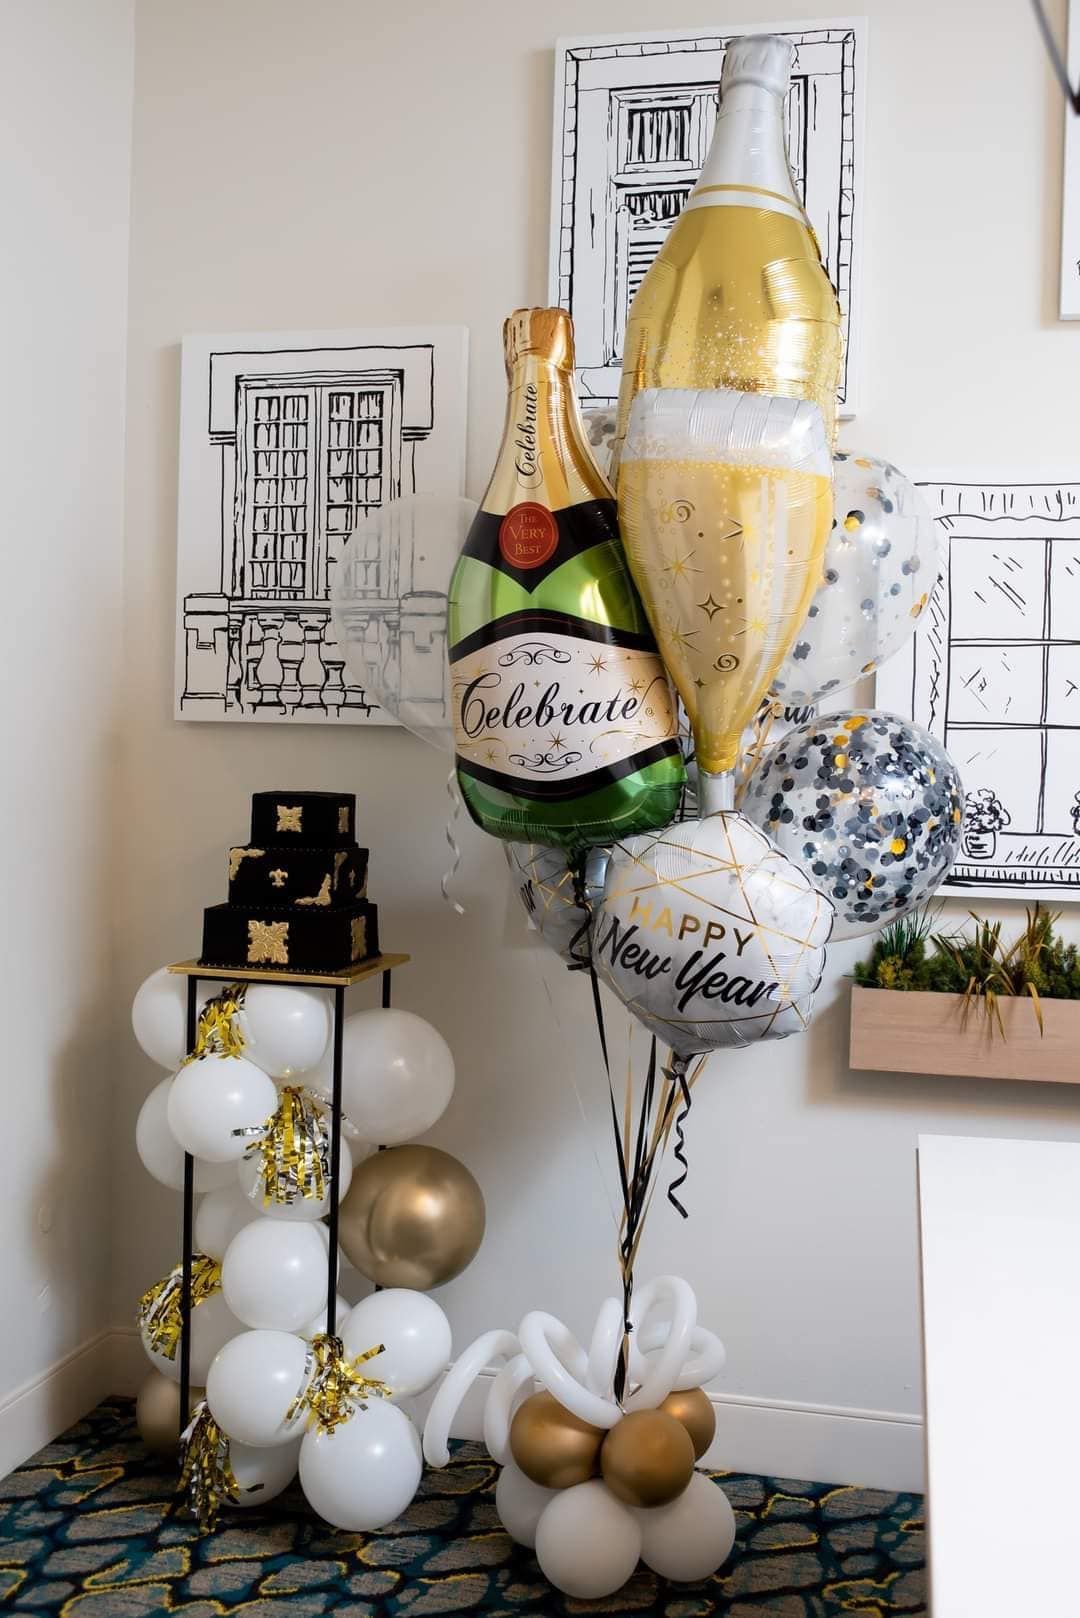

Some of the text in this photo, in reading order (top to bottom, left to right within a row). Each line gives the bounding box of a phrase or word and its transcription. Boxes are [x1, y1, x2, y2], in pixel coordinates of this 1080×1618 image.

[515, 382, 542, 487] Celebrate
[508, 525, 546, 540] VERY
[514, 543, 542, 555] BEST
[518, 513, 537, 524] THE
[457, 672, 645, 738] Celebrate
[628, 896, 755, 957] HAPPY
[598, 916, 780, 1013] New Year
